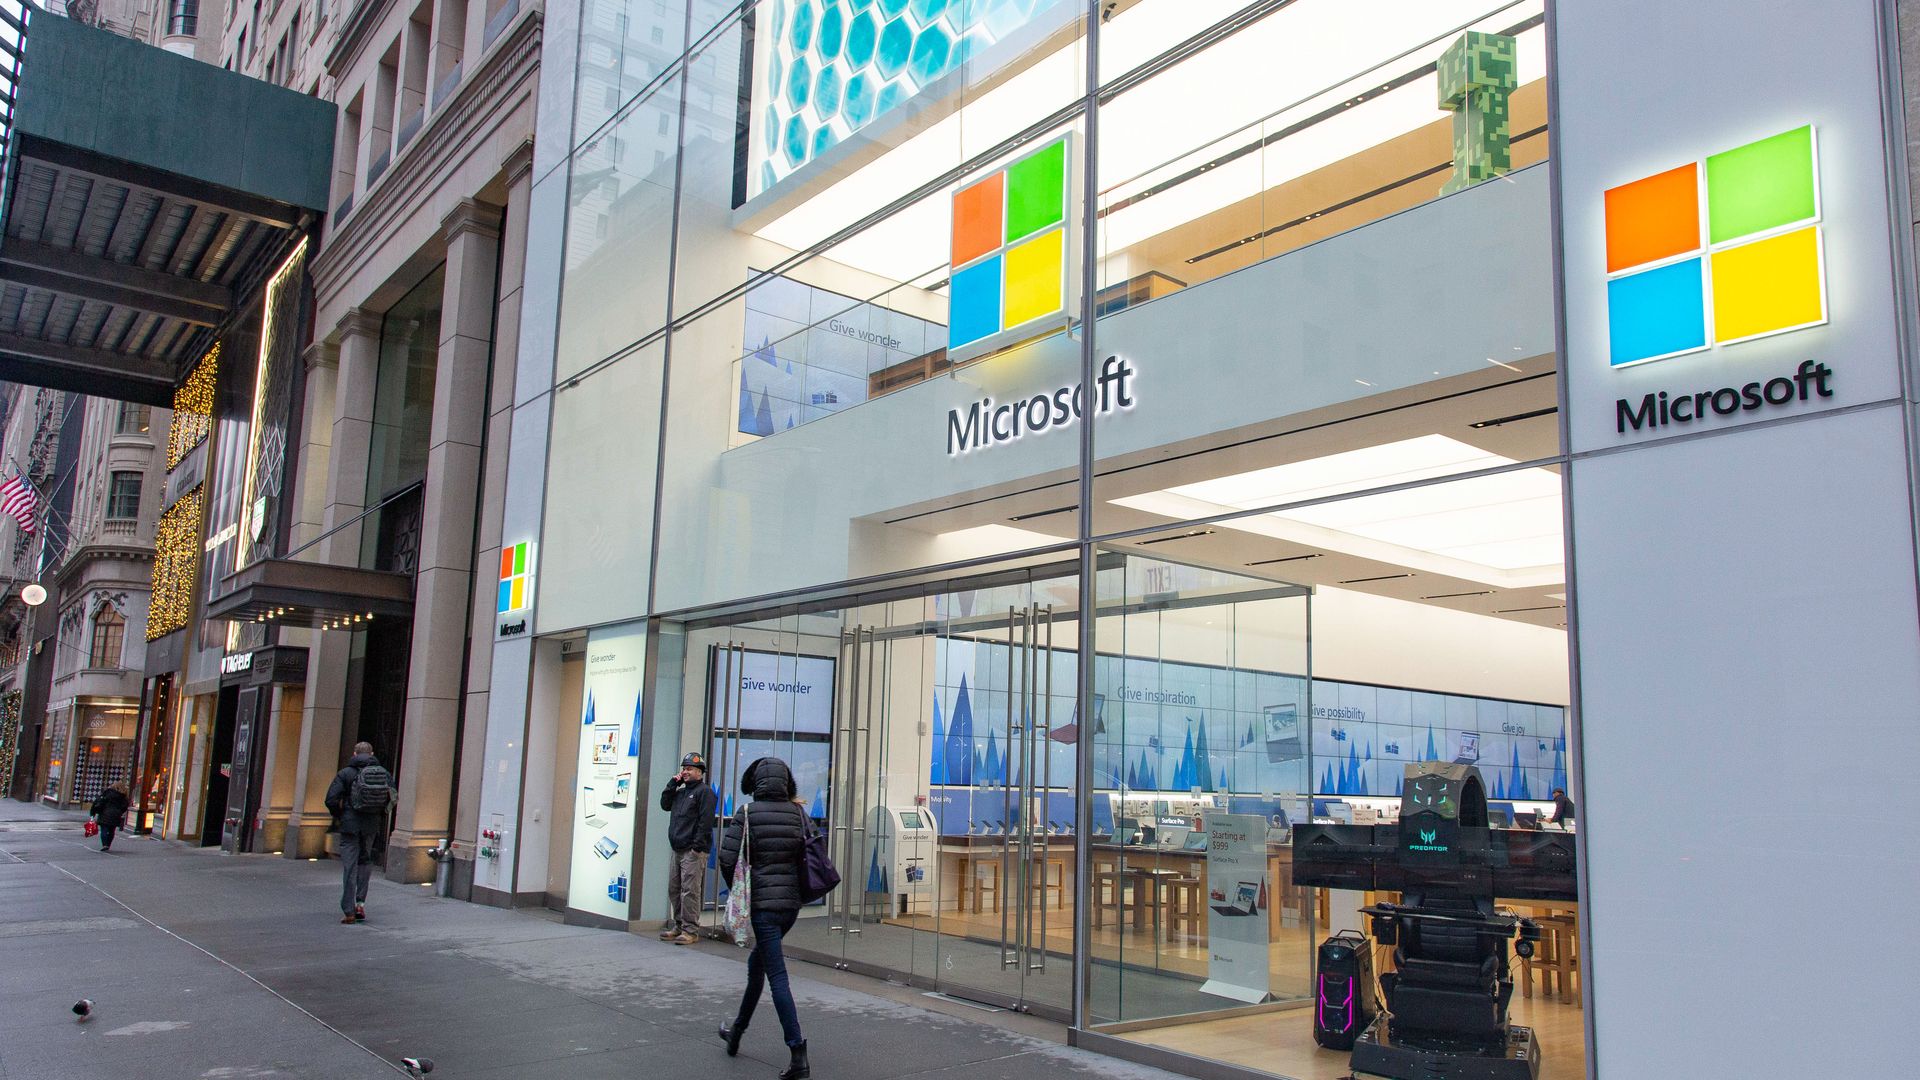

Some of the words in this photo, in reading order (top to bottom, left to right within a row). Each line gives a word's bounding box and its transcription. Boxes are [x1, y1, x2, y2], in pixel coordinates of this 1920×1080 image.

[829, 319, 855, 337] Give
[858, 329, 902, 349] wonder
[947, 355, 1135, 455] Microsoft
[1615, 359, 1834, 434] Microsoft
[500, 619, 526, 636] Microsoft
[741, 677, 766, 691] Give
[768, 681, 812, 694] wonder
[1117, 685, 1142, 700] Give
[1145, 687, 1196, 705] inspiration
[1311, 703, 1326, 717] ive
[1327, 706, 1366, 723] possibility
[90, 720, 106, 728] 689
[1502, 722, 1516, 733] Give
[1212, 830, 1238, 842] Starting
[1239, 833, 1246, 841] at
[1212, 841, 1229, 850] $999
